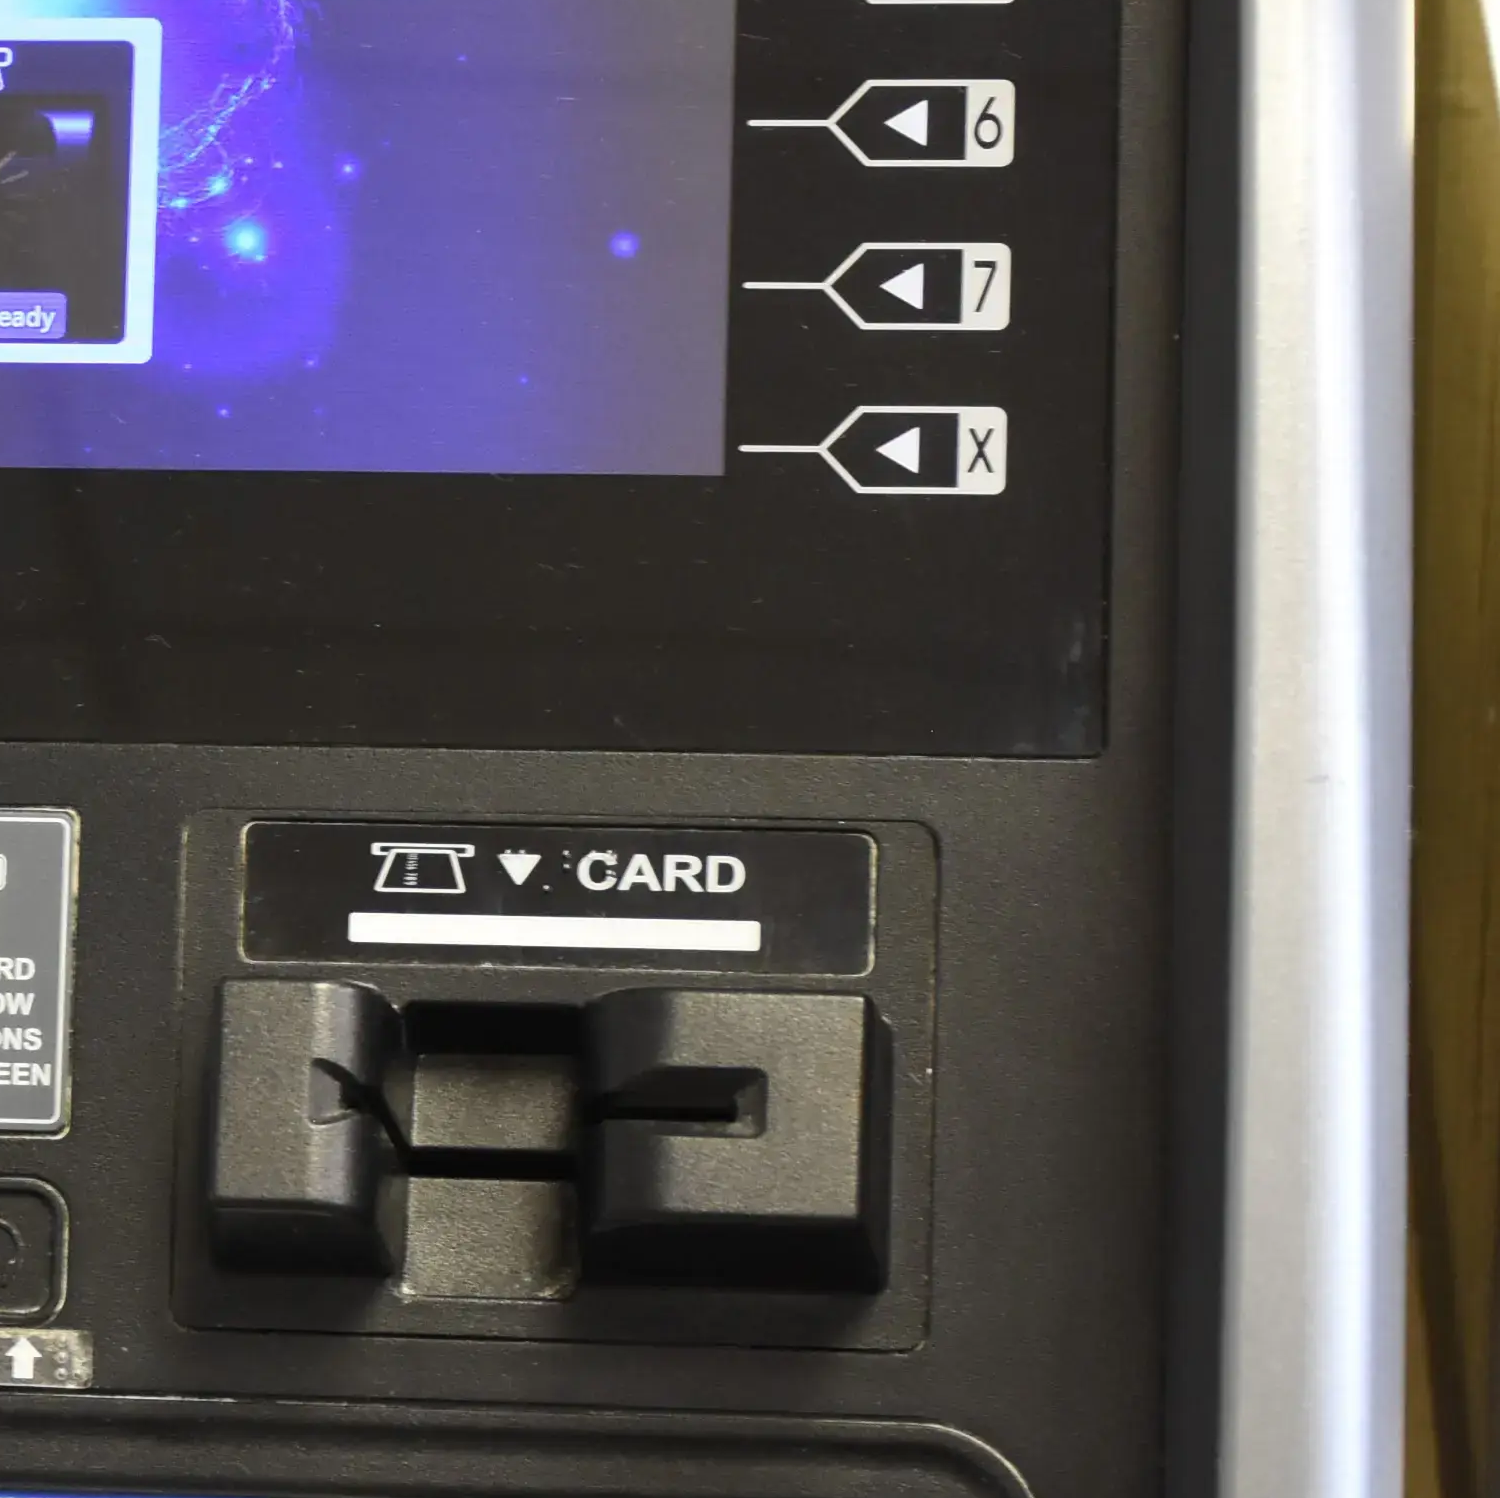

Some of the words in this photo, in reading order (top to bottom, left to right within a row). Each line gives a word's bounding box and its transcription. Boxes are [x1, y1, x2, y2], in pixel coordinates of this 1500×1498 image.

[974, 97, 1003, 149] 6
[973, 260, 998, 313] 7
[967, 427, 995, 474] X
[576, 851, 747, 893] CARD
